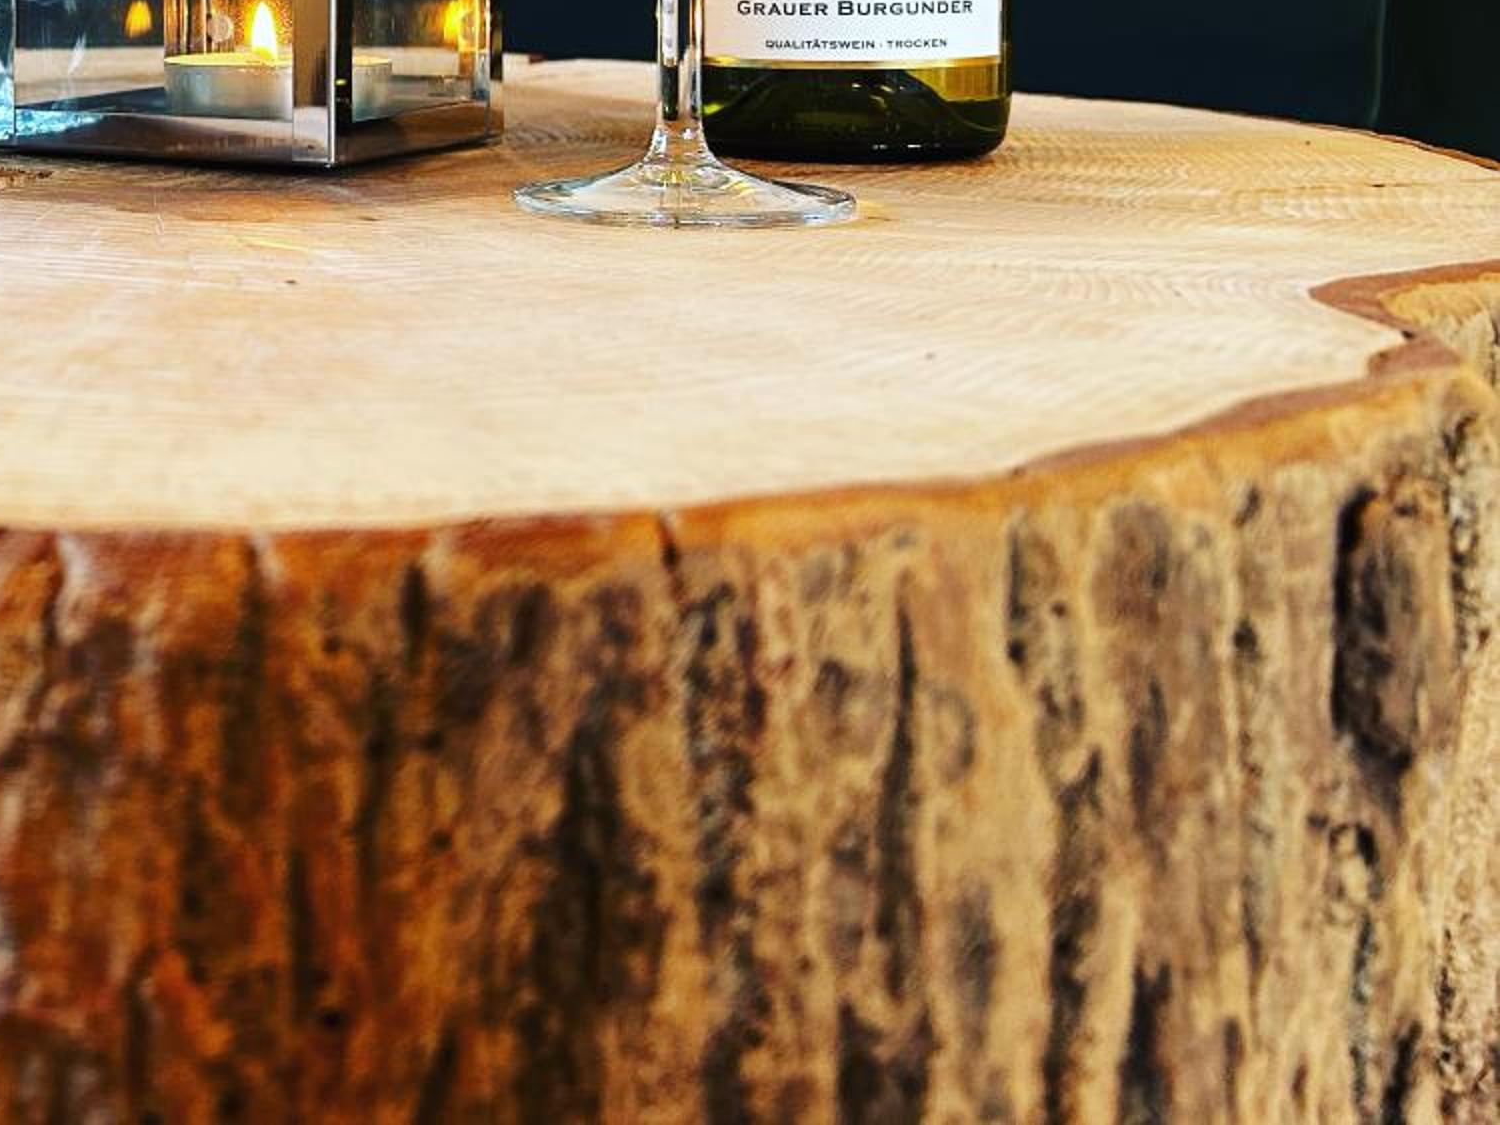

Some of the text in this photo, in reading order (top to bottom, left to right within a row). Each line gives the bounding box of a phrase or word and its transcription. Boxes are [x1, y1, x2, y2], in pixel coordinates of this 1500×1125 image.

[736, 0, 974, 17] GRAUER BURGUNDER
[764, 38, 947, 50] QUALITÄTSWEIN TROCKEN
